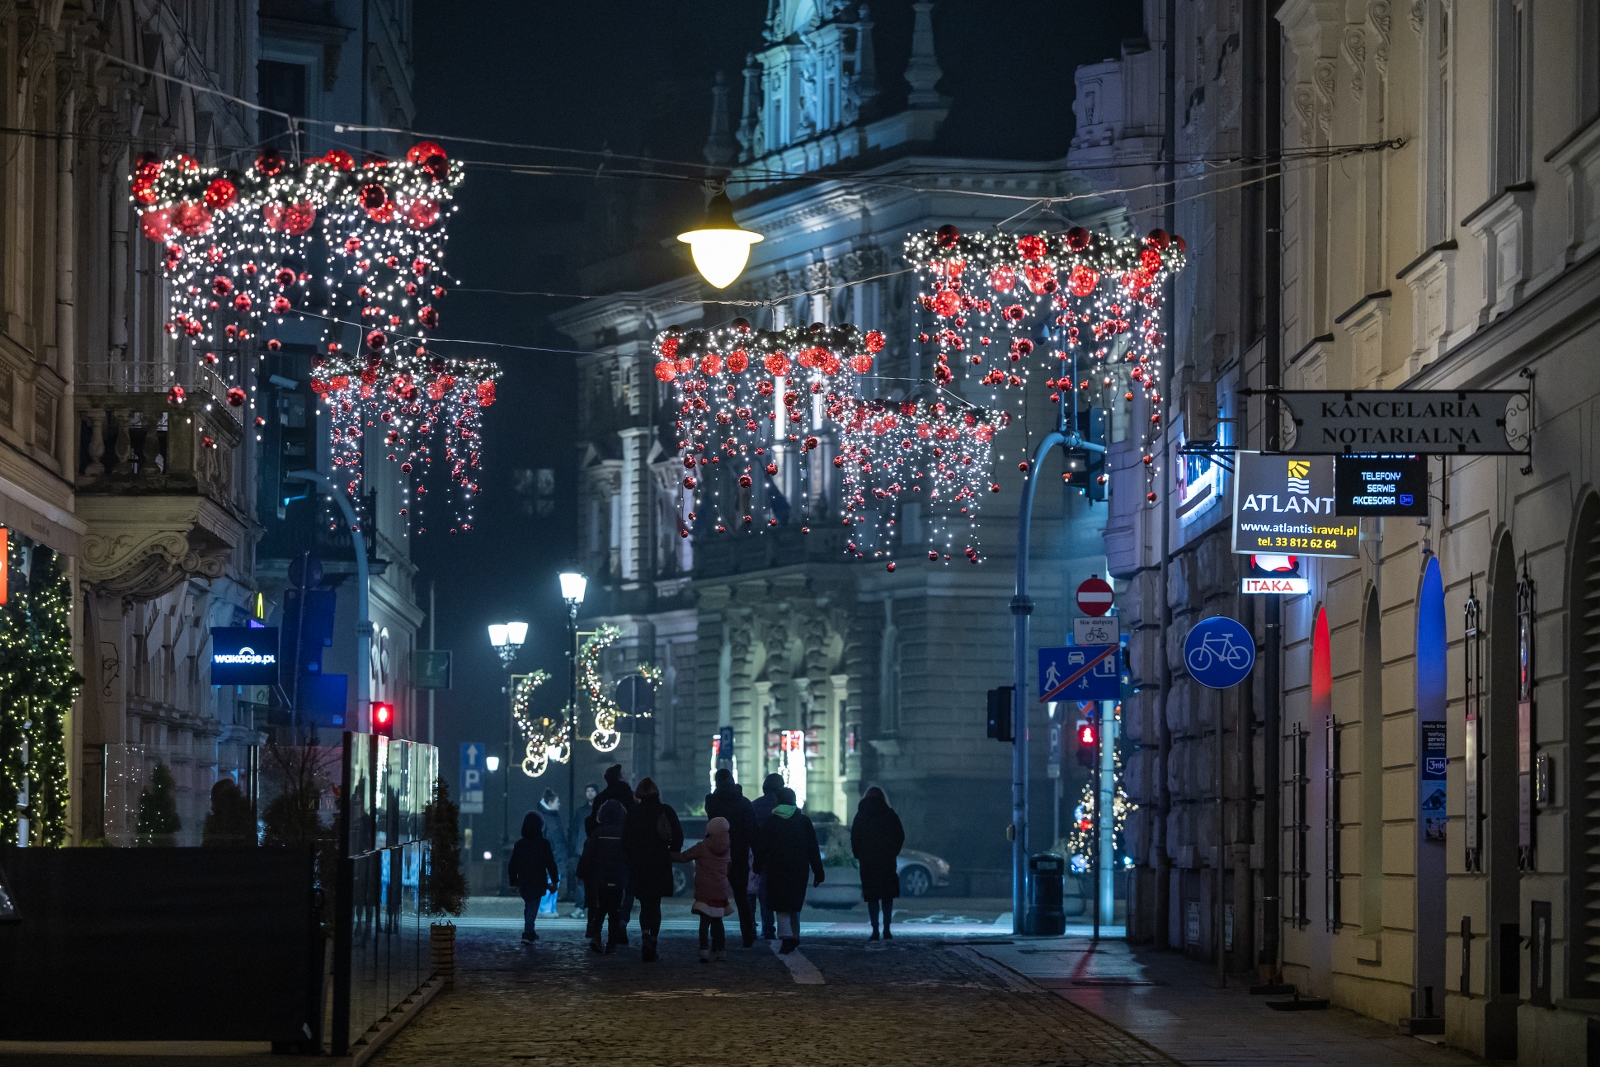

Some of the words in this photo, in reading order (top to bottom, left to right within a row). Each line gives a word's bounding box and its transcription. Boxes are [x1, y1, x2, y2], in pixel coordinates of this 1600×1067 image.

[1321, 402, 1482, 418] KANCELARIA
[1322, 428, 1482, 444] NOTARIALNA
[1361, 472, 1402, 481] TELEFONY
[1366, 484, 1396, 493] SERWIS
[1242, 493, 1335, 515] ATLANT
[1352, 496, 1396, 505] AKCESORIA
[1240, 522, 1357, 537] www.atlantistravel.pl
[1257, 537, 1273, 547] tel.
[1275, 537, 1288, 547] 33
[1289, 538, 1308, 548] 812
[1310, 538, 1322, 549] 62
[1324, 539, 1337, 549] 64
[1247, 580, 1293, 591] ITAKA
[214, 654, 276, 665] wakacje.pl
[465, 769, 480, 788] P
